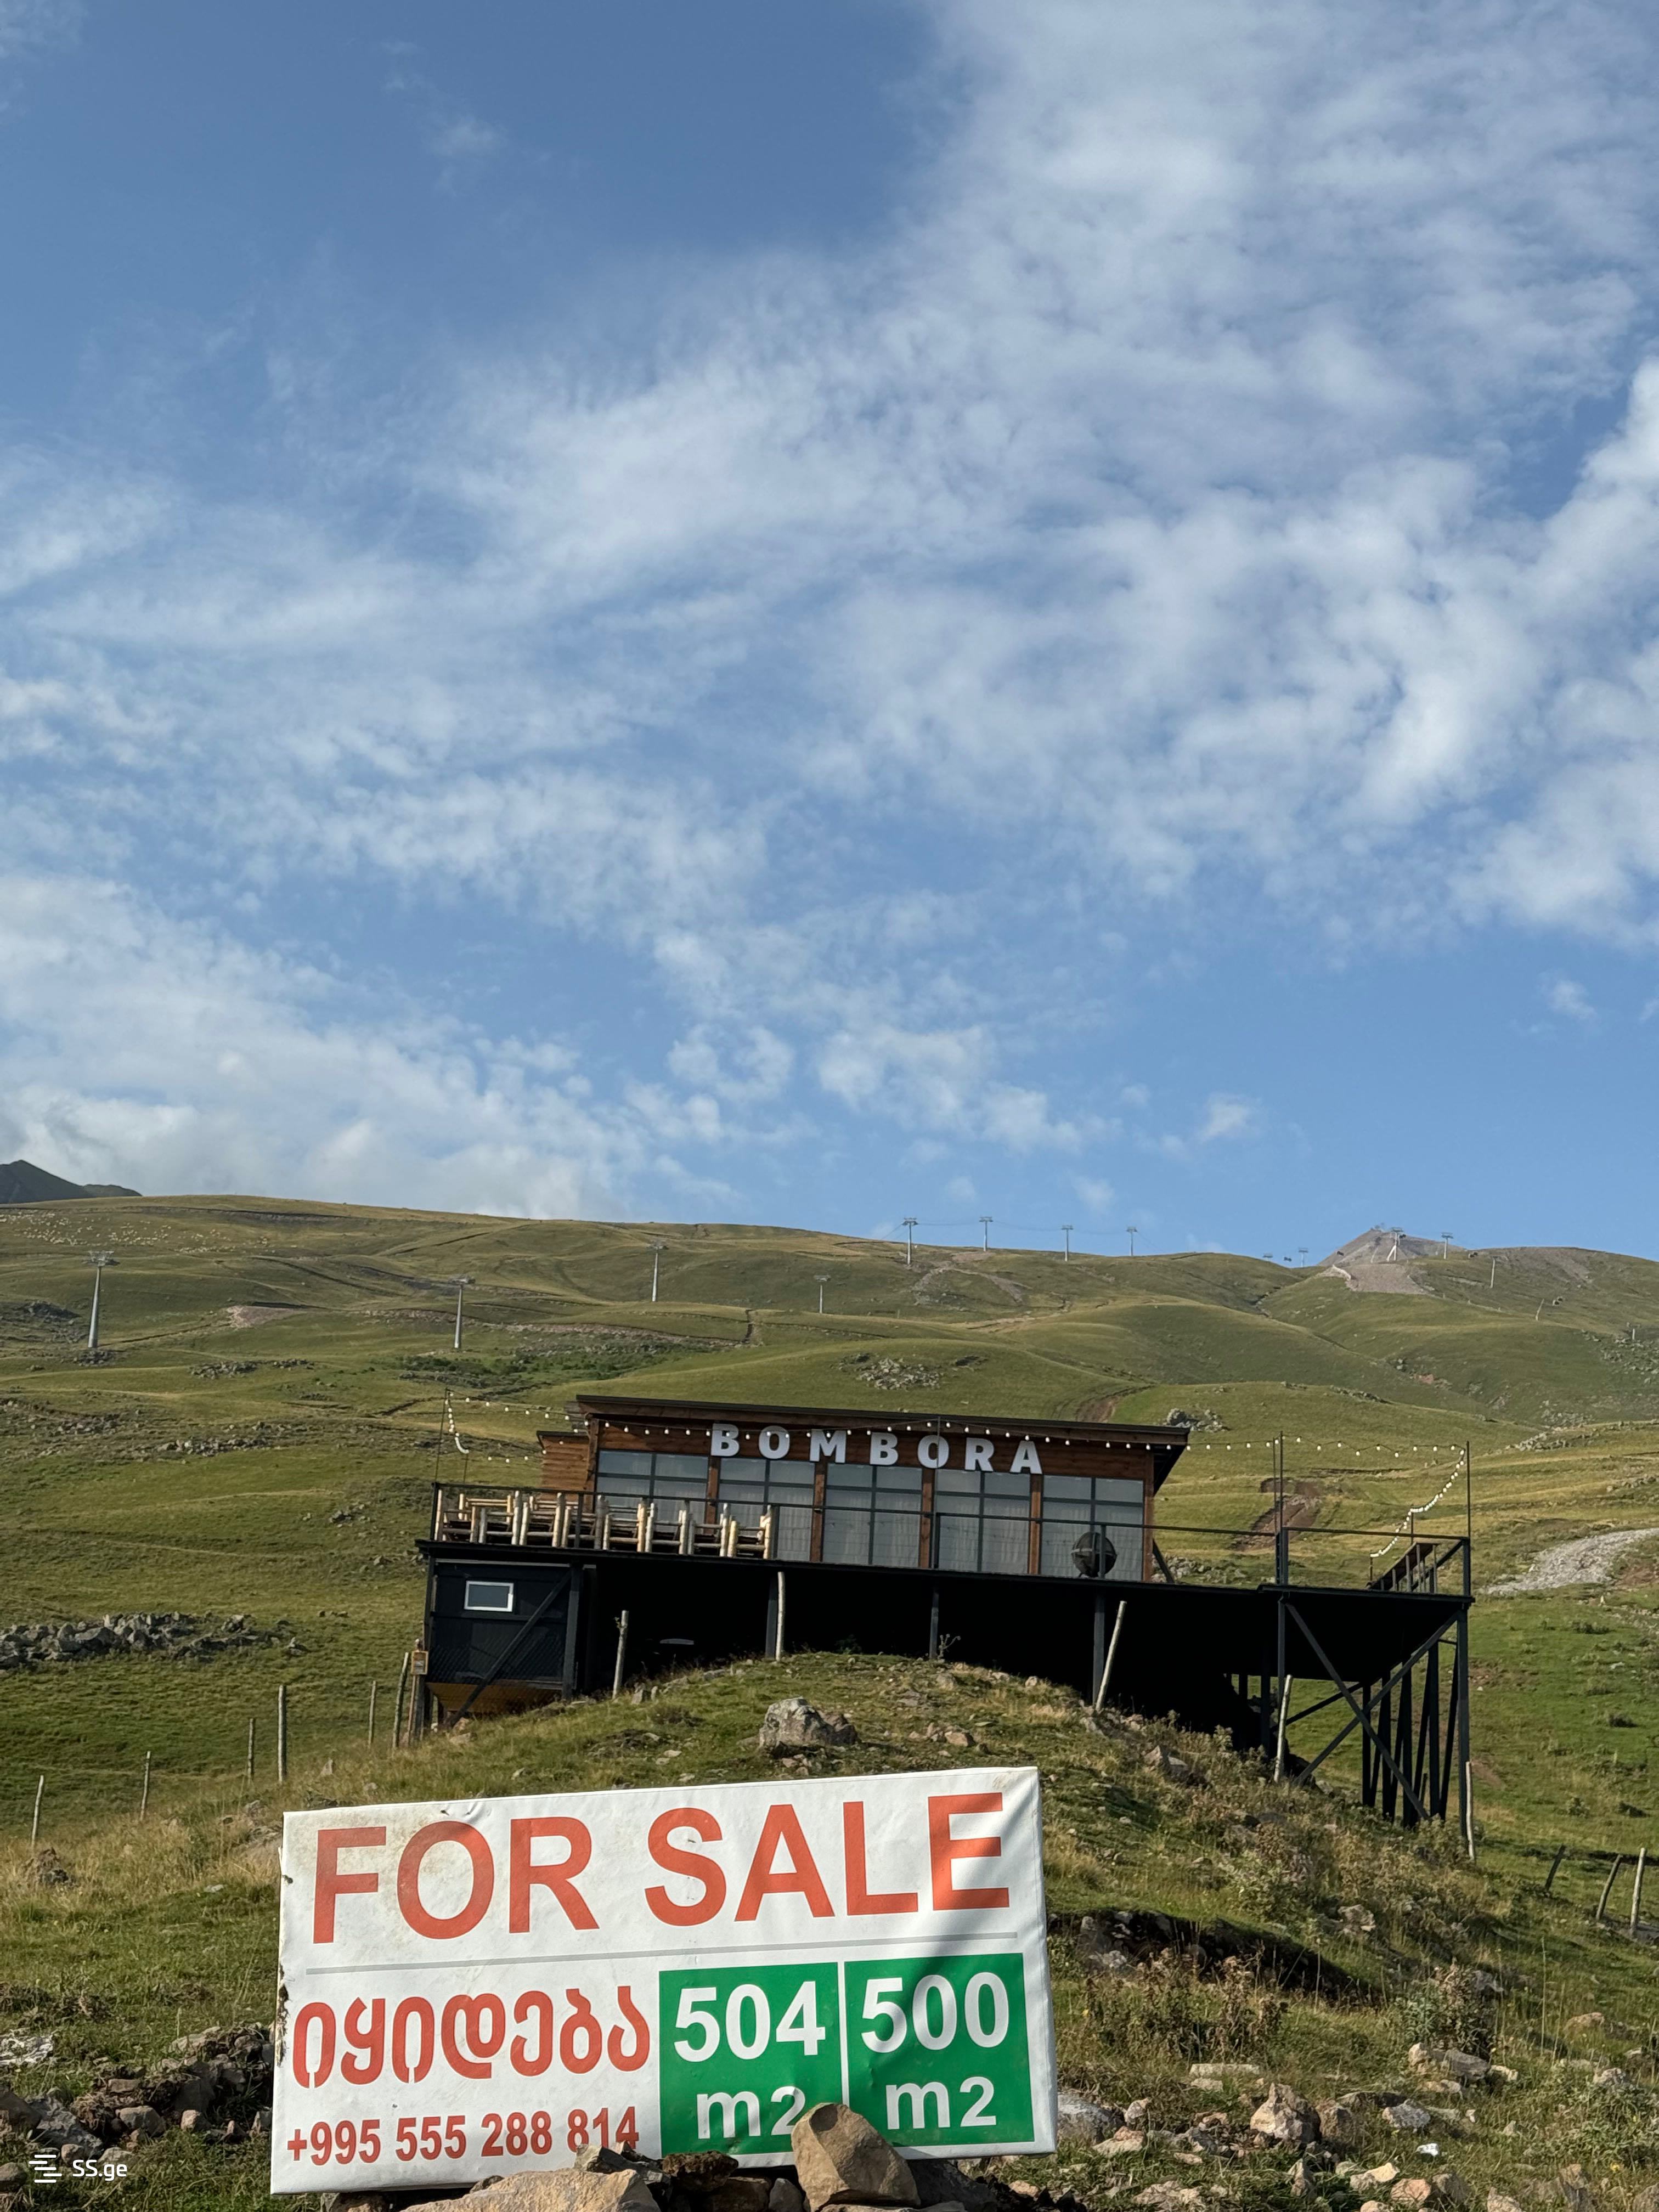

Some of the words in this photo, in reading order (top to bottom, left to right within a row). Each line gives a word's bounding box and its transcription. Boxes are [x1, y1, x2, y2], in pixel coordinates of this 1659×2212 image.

[710, 1423, 1042, 1475] BOMBORA
[313, 1815, 600, 1944] FOR
[644, 1792, 1010, 1926] SALE
[292, 1985, 650, 2089] იყიდება
[674, 1981, 826, 2062] 504
[861, 1972, 1009, 2053] 500
[287, 2119, 380, 2165] +995
[396, 2115, 466, 2162] 555
[482, 2111, 551, 2157] 288
[567, 2106, 639, 2153] 814
[697, 2086, 806, 2140] m2
[886, 2076, 997, 2130] m2
